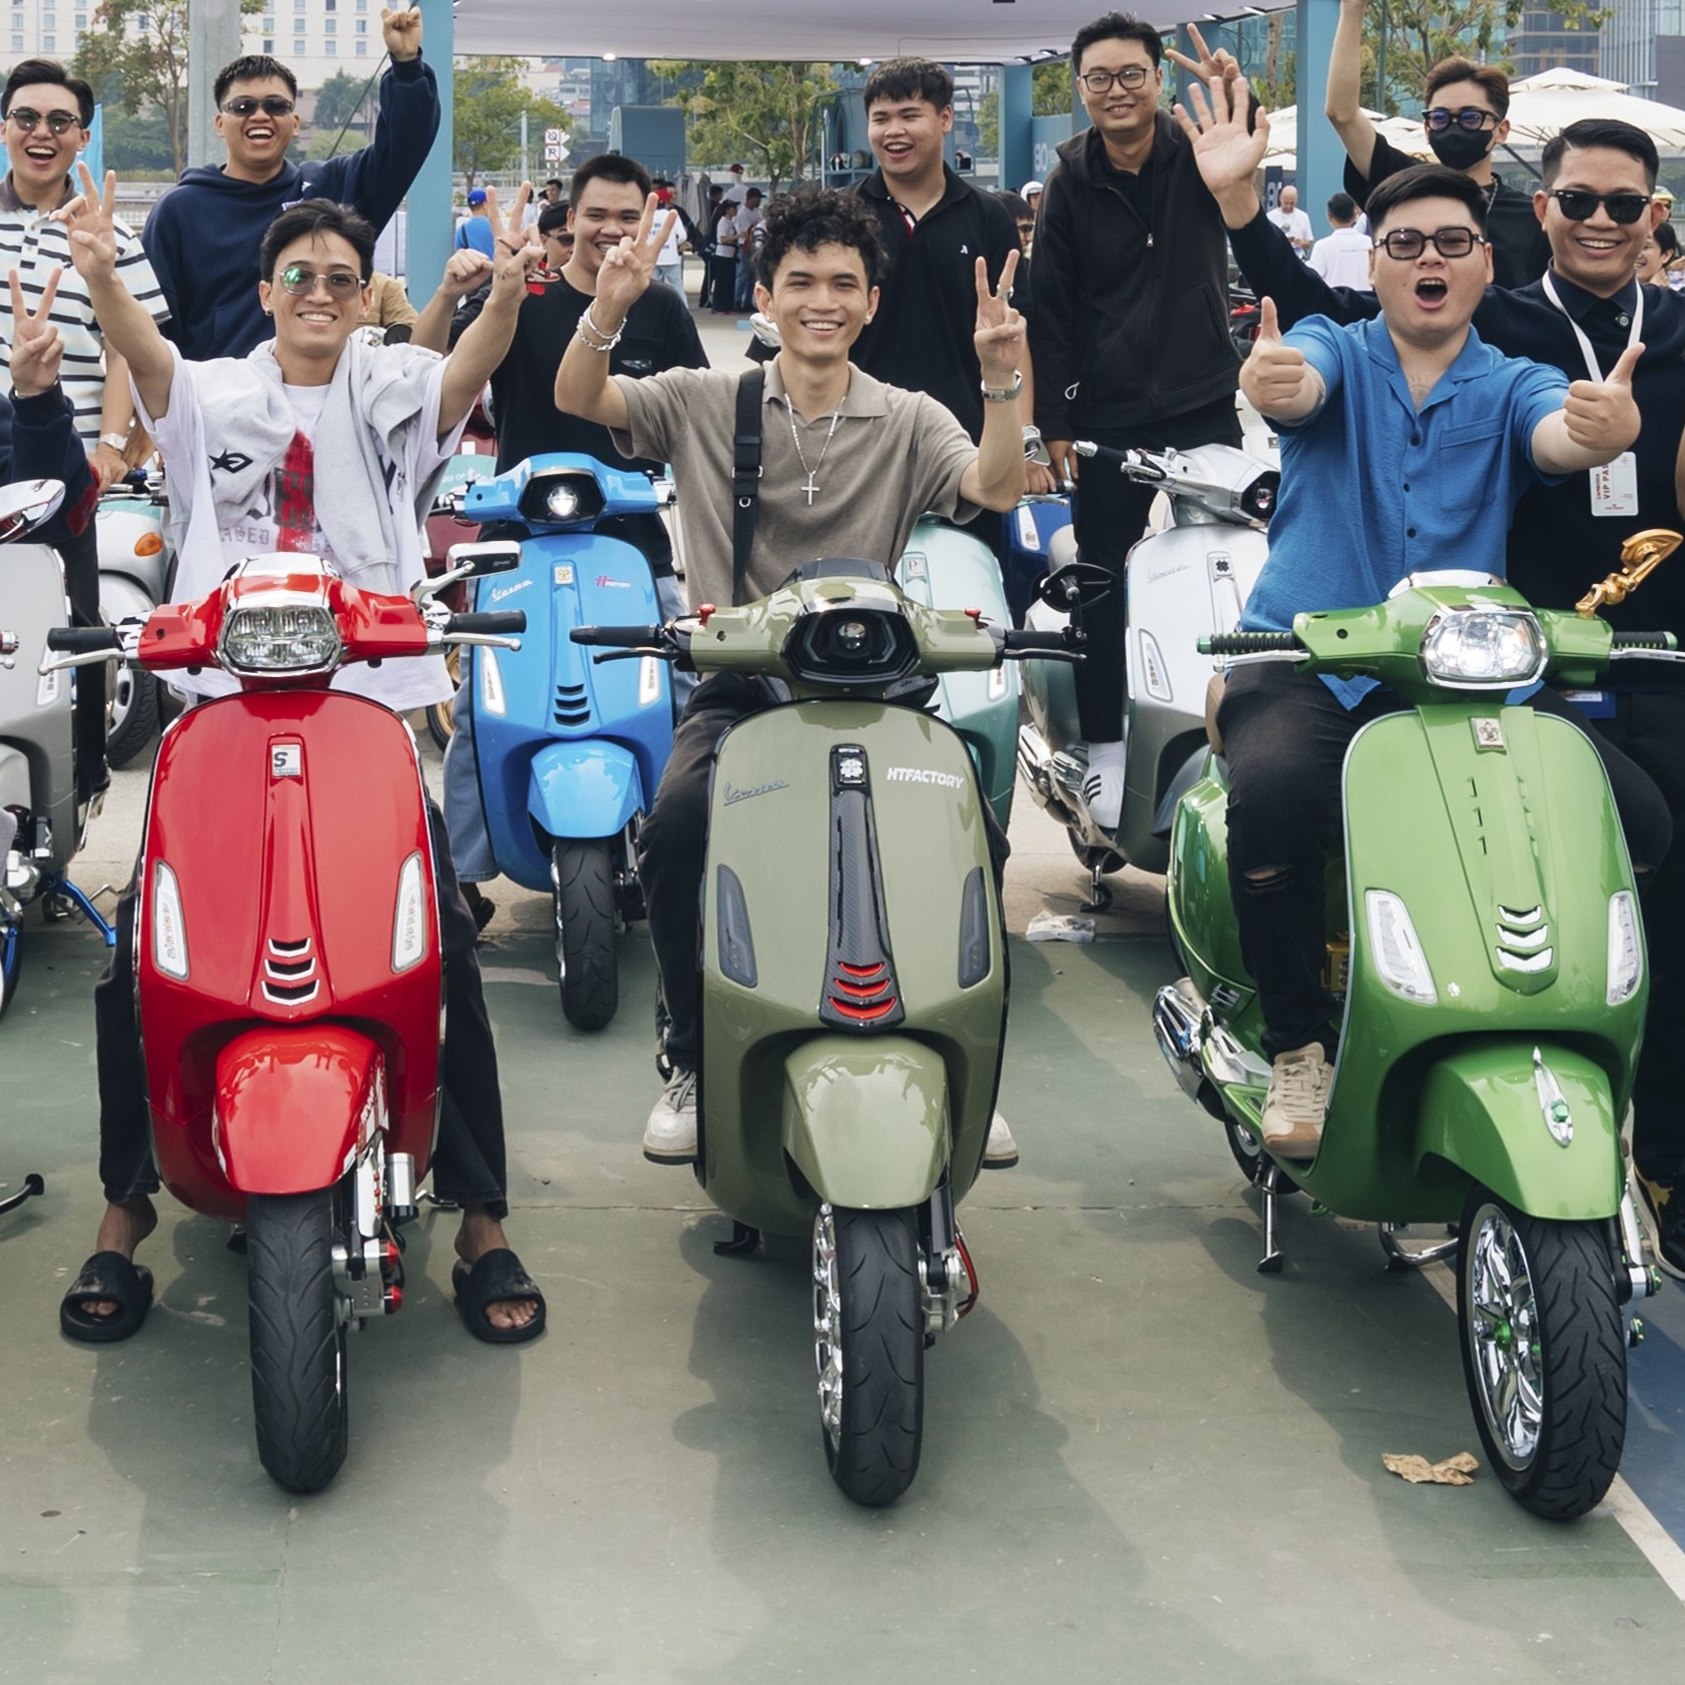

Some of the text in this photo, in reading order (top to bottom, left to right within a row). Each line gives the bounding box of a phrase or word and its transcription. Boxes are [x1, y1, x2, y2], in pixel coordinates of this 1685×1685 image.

[1603, 484, 1611, 500] VIP
[491, 578, 534, 602] Vespa
[273, 751, 289, 768] S
[886, 767, 964, 789] HTFACTORY
